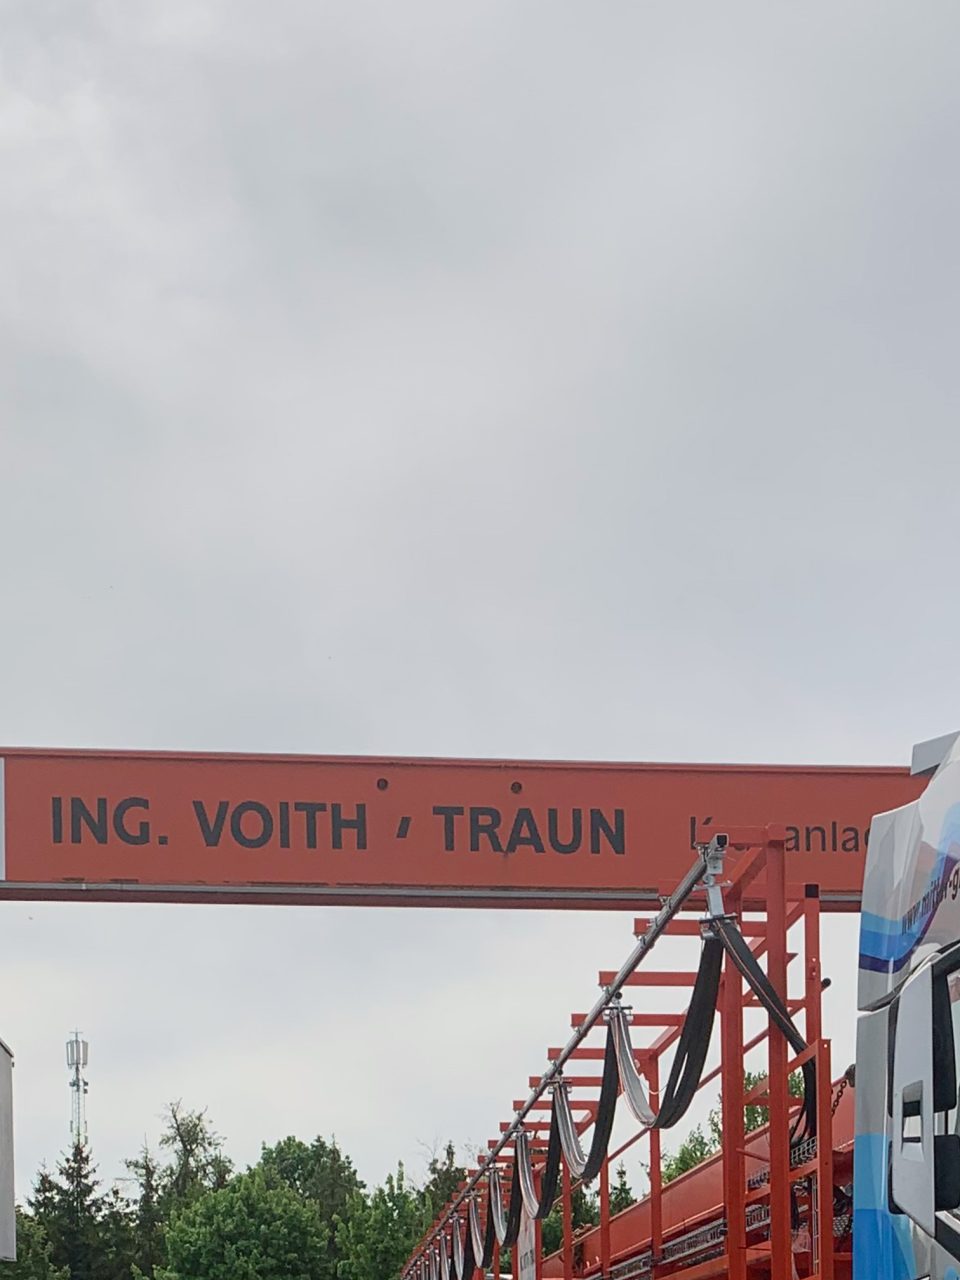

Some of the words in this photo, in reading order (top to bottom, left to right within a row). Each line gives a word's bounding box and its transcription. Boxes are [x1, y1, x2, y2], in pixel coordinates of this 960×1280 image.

[51, 796, 170, 847] ING.
[193, 800, 368, 851] VOITH
[433, 804, 627, 857] TRAUN
